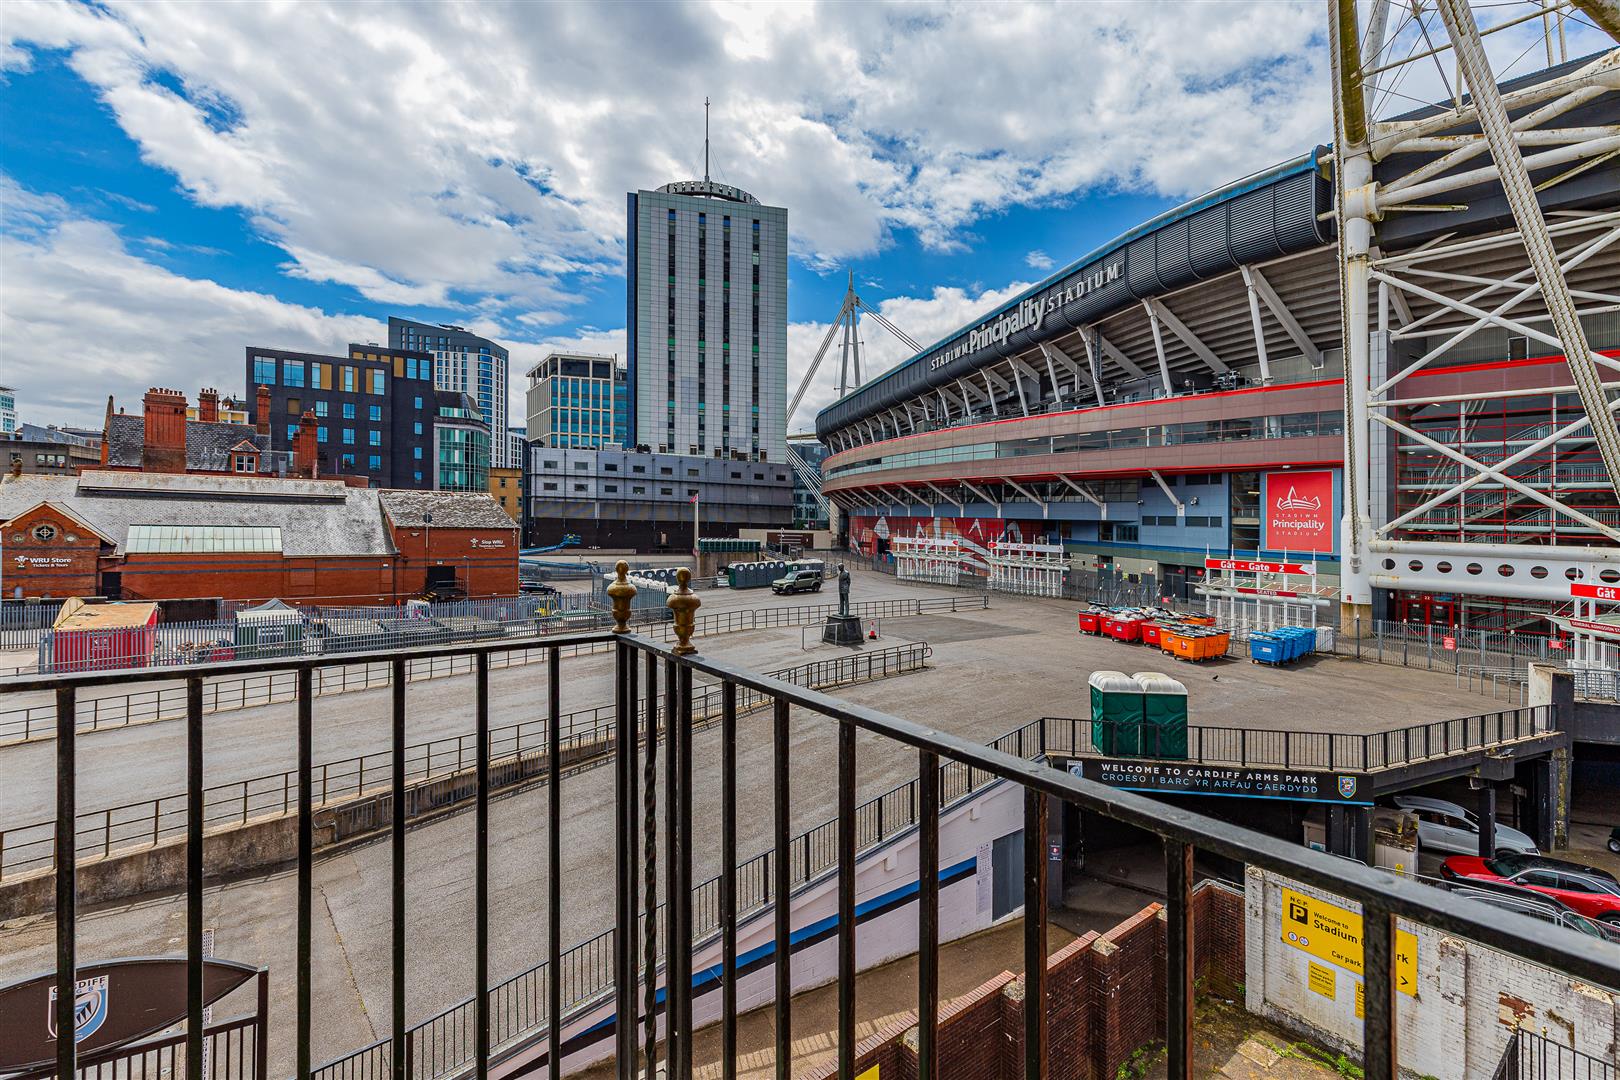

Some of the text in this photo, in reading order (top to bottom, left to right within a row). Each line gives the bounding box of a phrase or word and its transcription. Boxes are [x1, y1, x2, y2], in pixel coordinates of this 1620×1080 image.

[931, 263, 1119, 371] STADIWM Principality STADIUM
[1272, 519, 1325, 532] Principality
[1248, 563, 1270, 571] Gate
[1278, 564, 1285, 573] 2
[1101, 763, 1318, 785] WELCOME TO CARDIFF ARMS PARK
[1101, 773, 1147, 783] CROESO
[1160, 776, 1190, 786] BARC
[1195, 779, 1209, 787] YR
[1214, 780, 1251, 790] ARFAU
[1256, 783, 1318, 794] CAERDYDD
[1313, 911, 1341, 927] Welcome
[1313, 919, 1358, 944] Stadium
[1331, 950, 1362, 968] Car park
